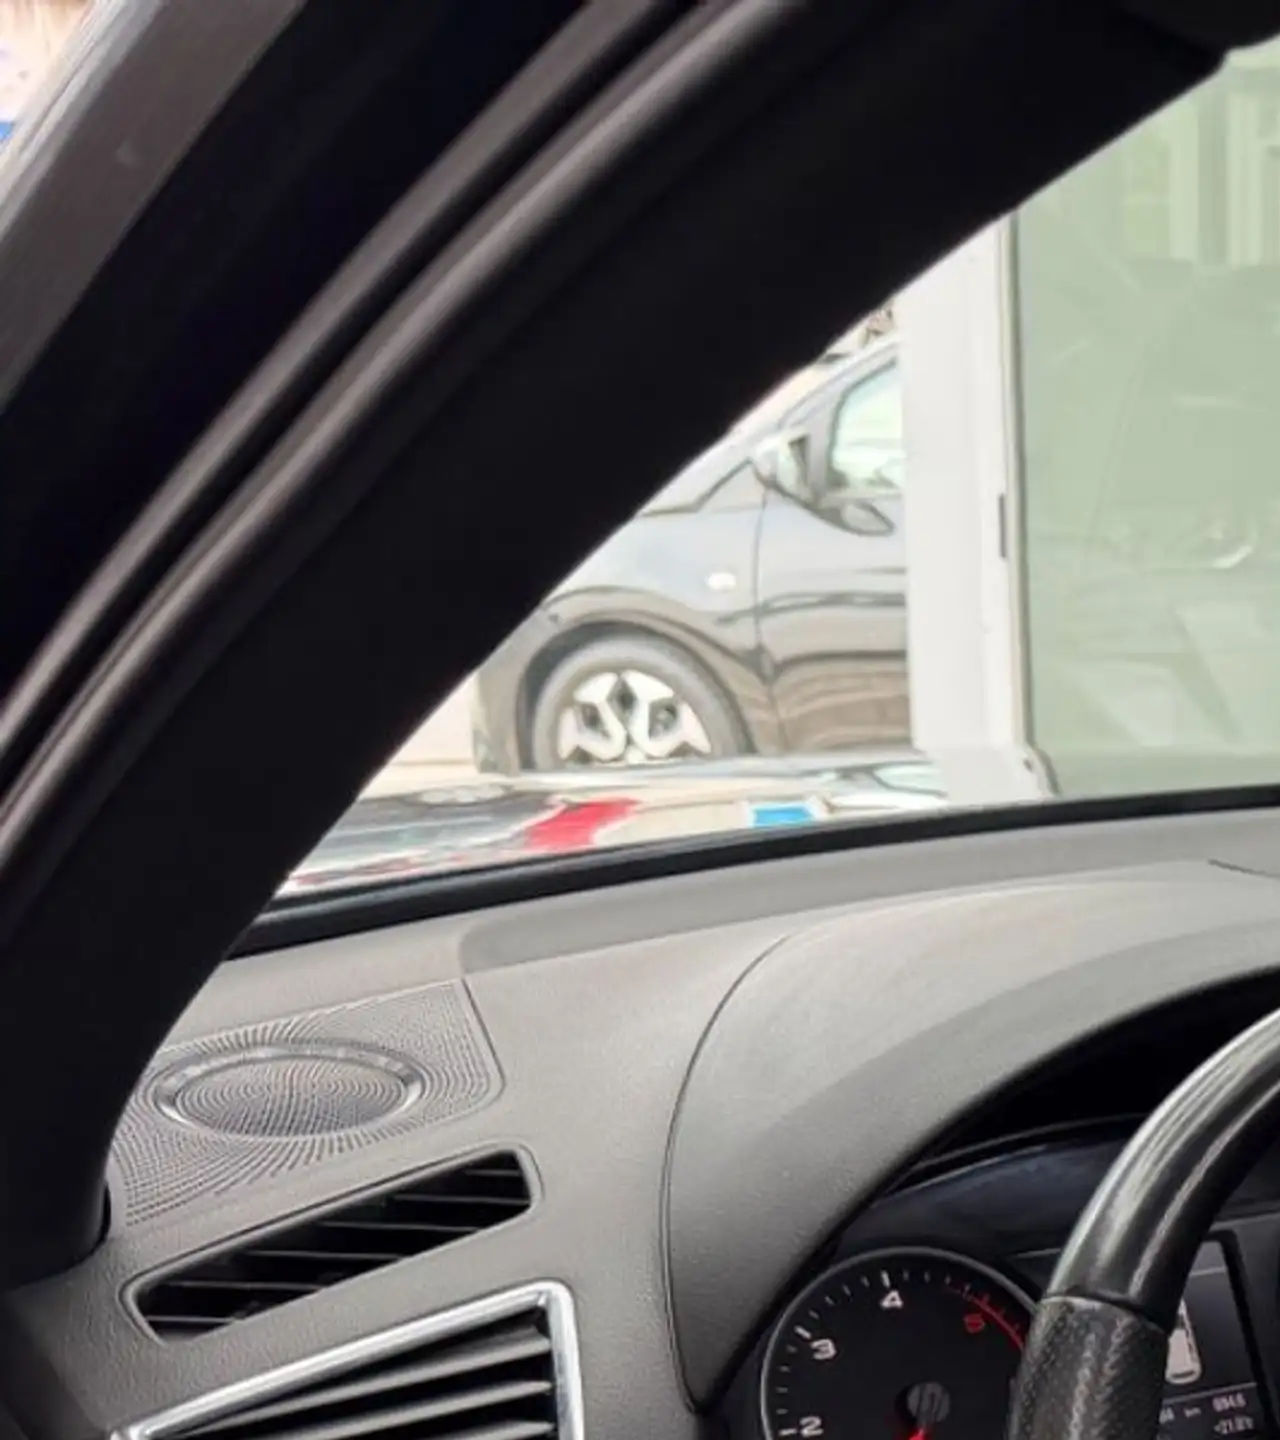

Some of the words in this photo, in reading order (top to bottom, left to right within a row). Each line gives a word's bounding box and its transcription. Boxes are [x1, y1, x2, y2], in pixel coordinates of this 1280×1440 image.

[880, 1291, 903, 1309] 4
[811, 1339, 837, 1360] 3
[800, 1416, 823, 1437] 2
